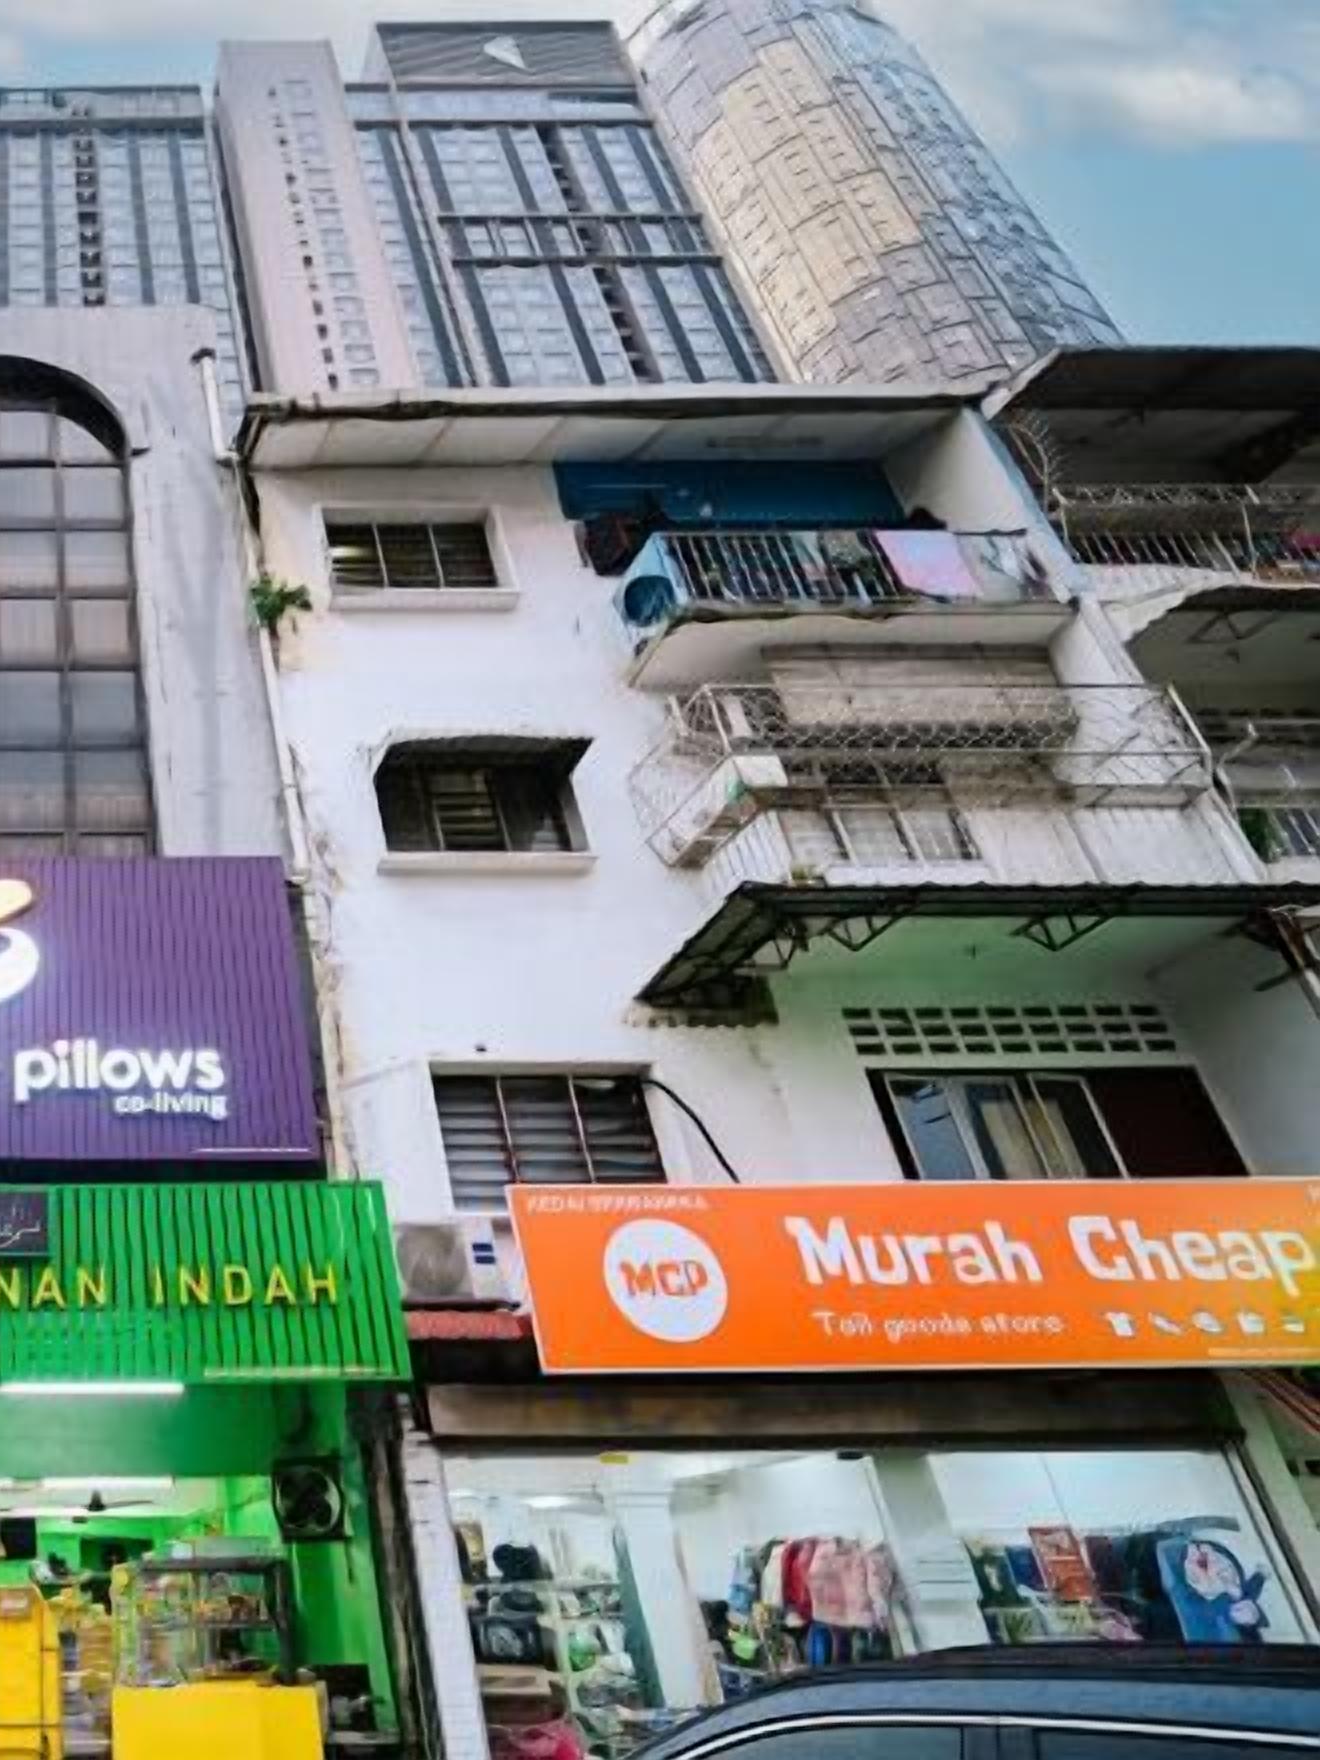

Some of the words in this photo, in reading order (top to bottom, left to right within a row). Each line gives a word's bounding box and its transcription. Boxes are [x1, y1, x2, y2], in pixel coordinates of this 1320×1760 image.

[14, 1038, 225, 1103] pillows
[114, 1091, 228, 1121] co-living
[620, 1259, 708, 1297] MCP
[783, 1215, 1044, 1286] Murah
[1068, 1214, 1318, 1299] Cheap
[153, 1263, 337, 1306] INDAH
